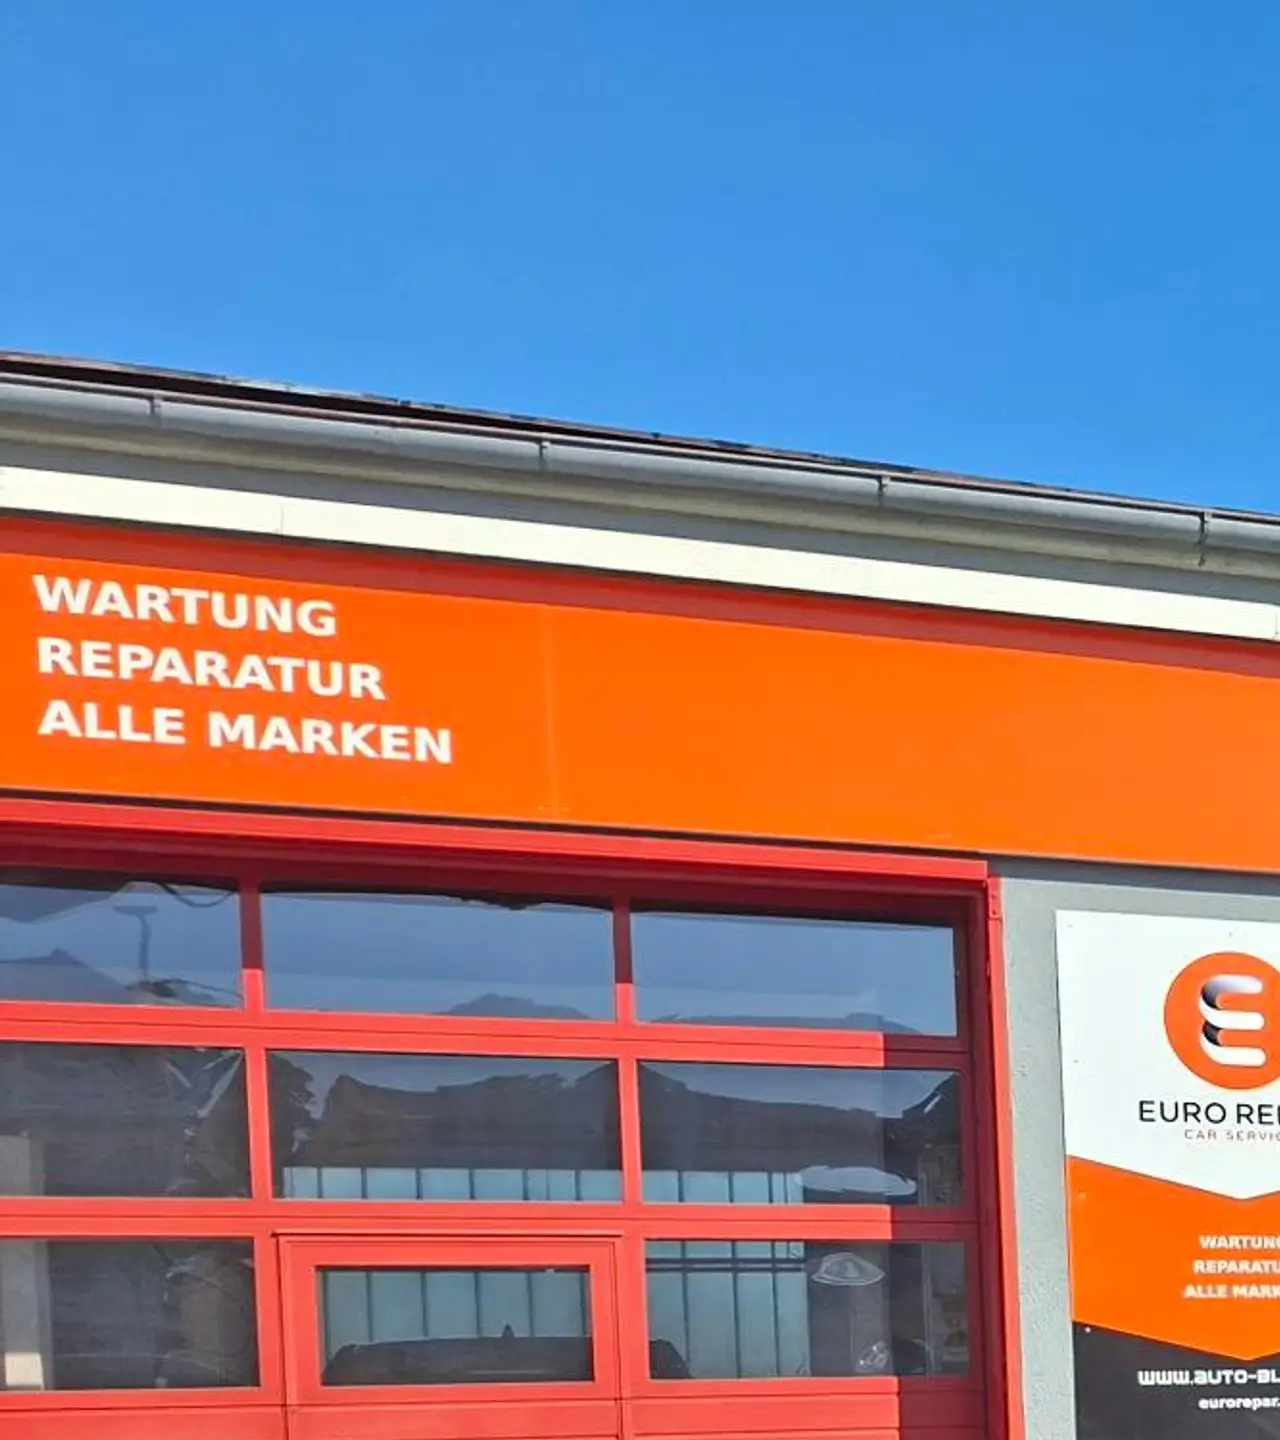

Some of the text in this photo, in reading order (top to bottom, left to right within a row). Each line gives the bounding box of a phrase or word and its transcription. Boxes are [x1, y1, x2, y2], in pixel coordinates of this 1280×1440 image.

[32, 573, 337, 637] WARTUNG
[37, 637, 386, 700] REPARATUR
[38, 699, 453, 764] ALLE MARKEN
[1138, 1100, 1227, 1124] EURO
[1184, 1129, 1217, 1140] CAR
[1184, 1284, 1228, 1299] ALLE
